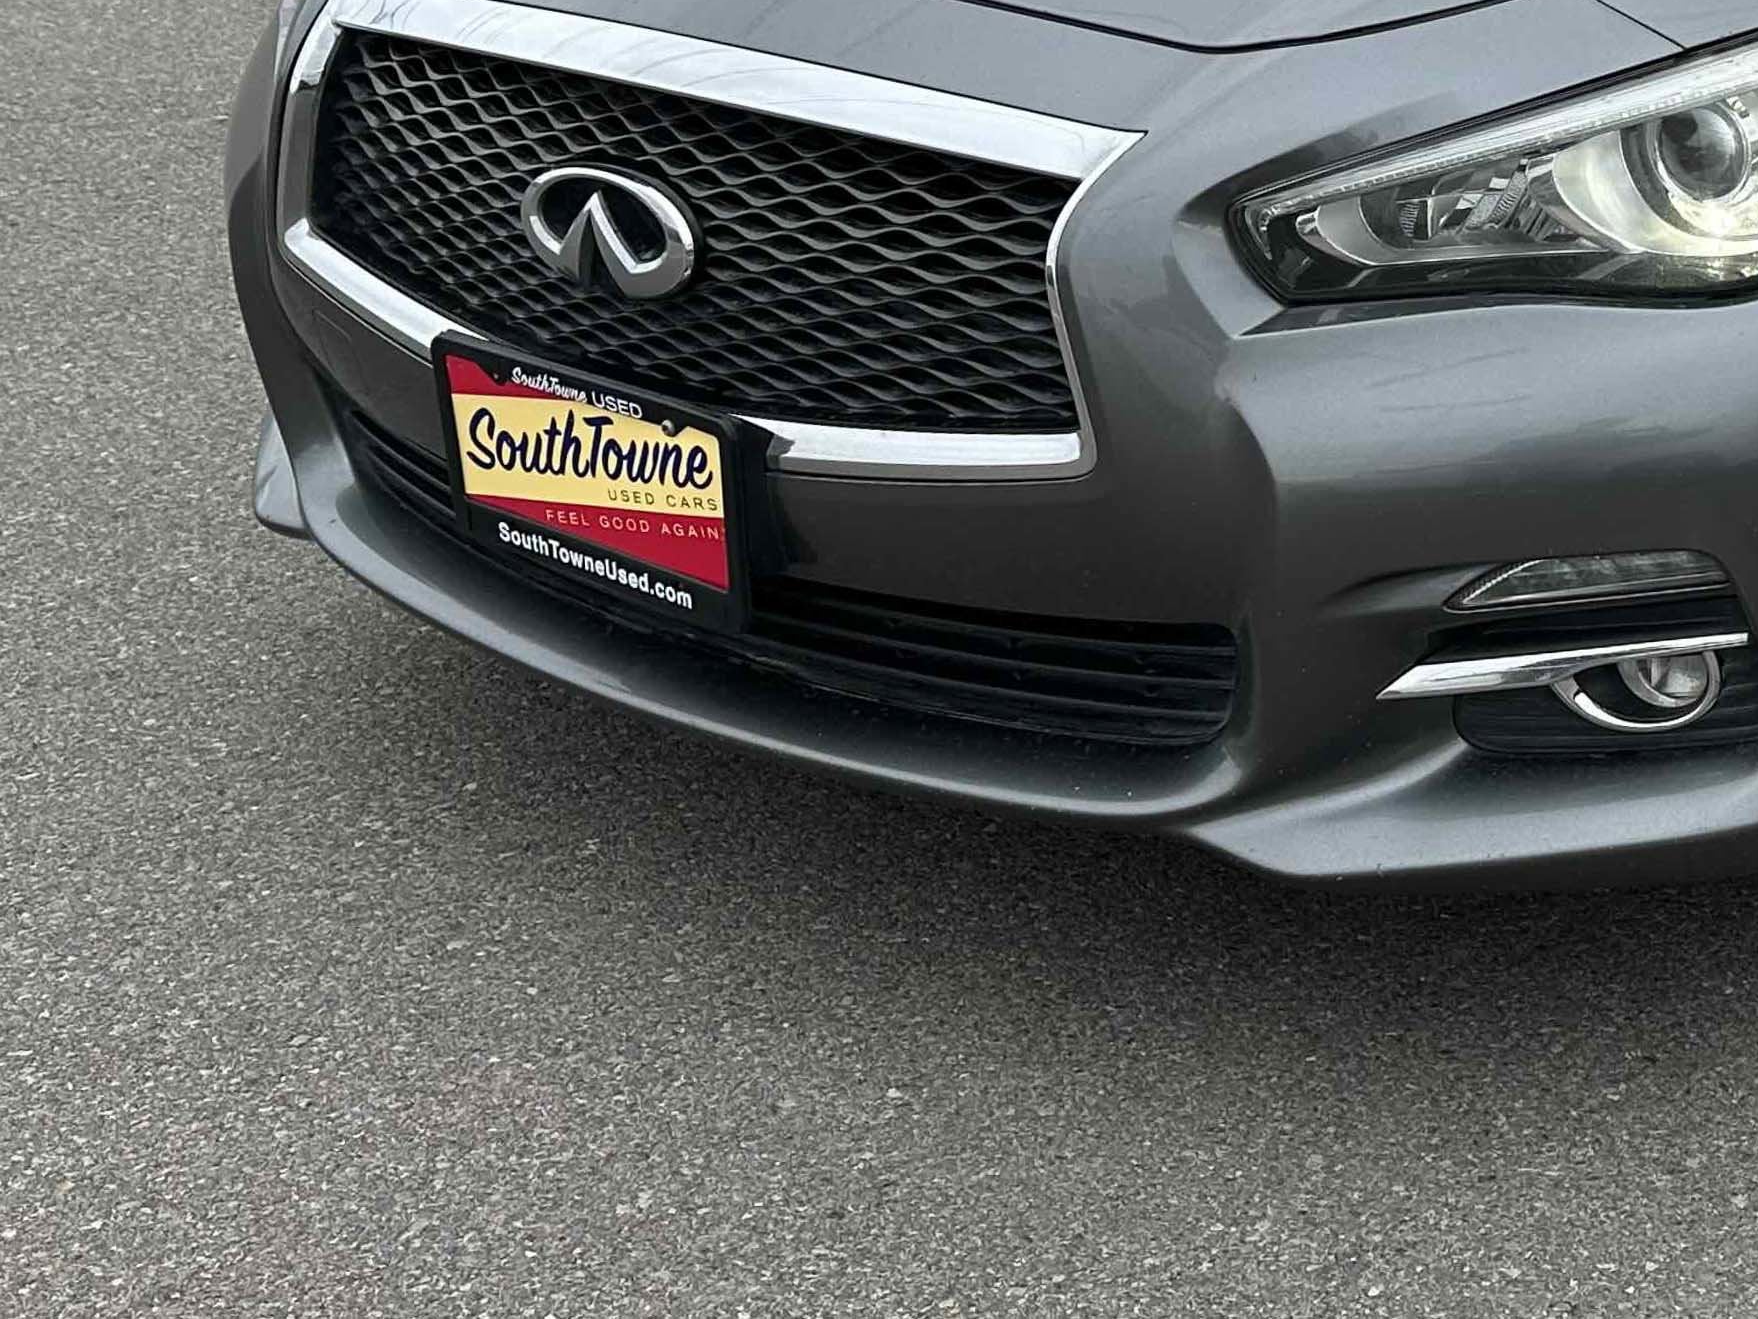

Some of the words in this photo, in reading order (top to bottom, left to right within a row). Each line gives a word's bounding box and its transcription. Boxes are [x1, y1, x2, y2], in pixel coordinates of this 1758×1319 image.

[511, 366, 587, 403] SouthTowne
[591, 391, 643, 419] USED
[467, 408, 713, 490] SouthTowne
[545, 508, 590, 528] FEEL
[598, 514, 650, 533] GOOD
[607, 488, 655, 505] USED
[665, 494, 718, 511] CARS
[498, 521, 693, 610] SouthTowneUsed.com
